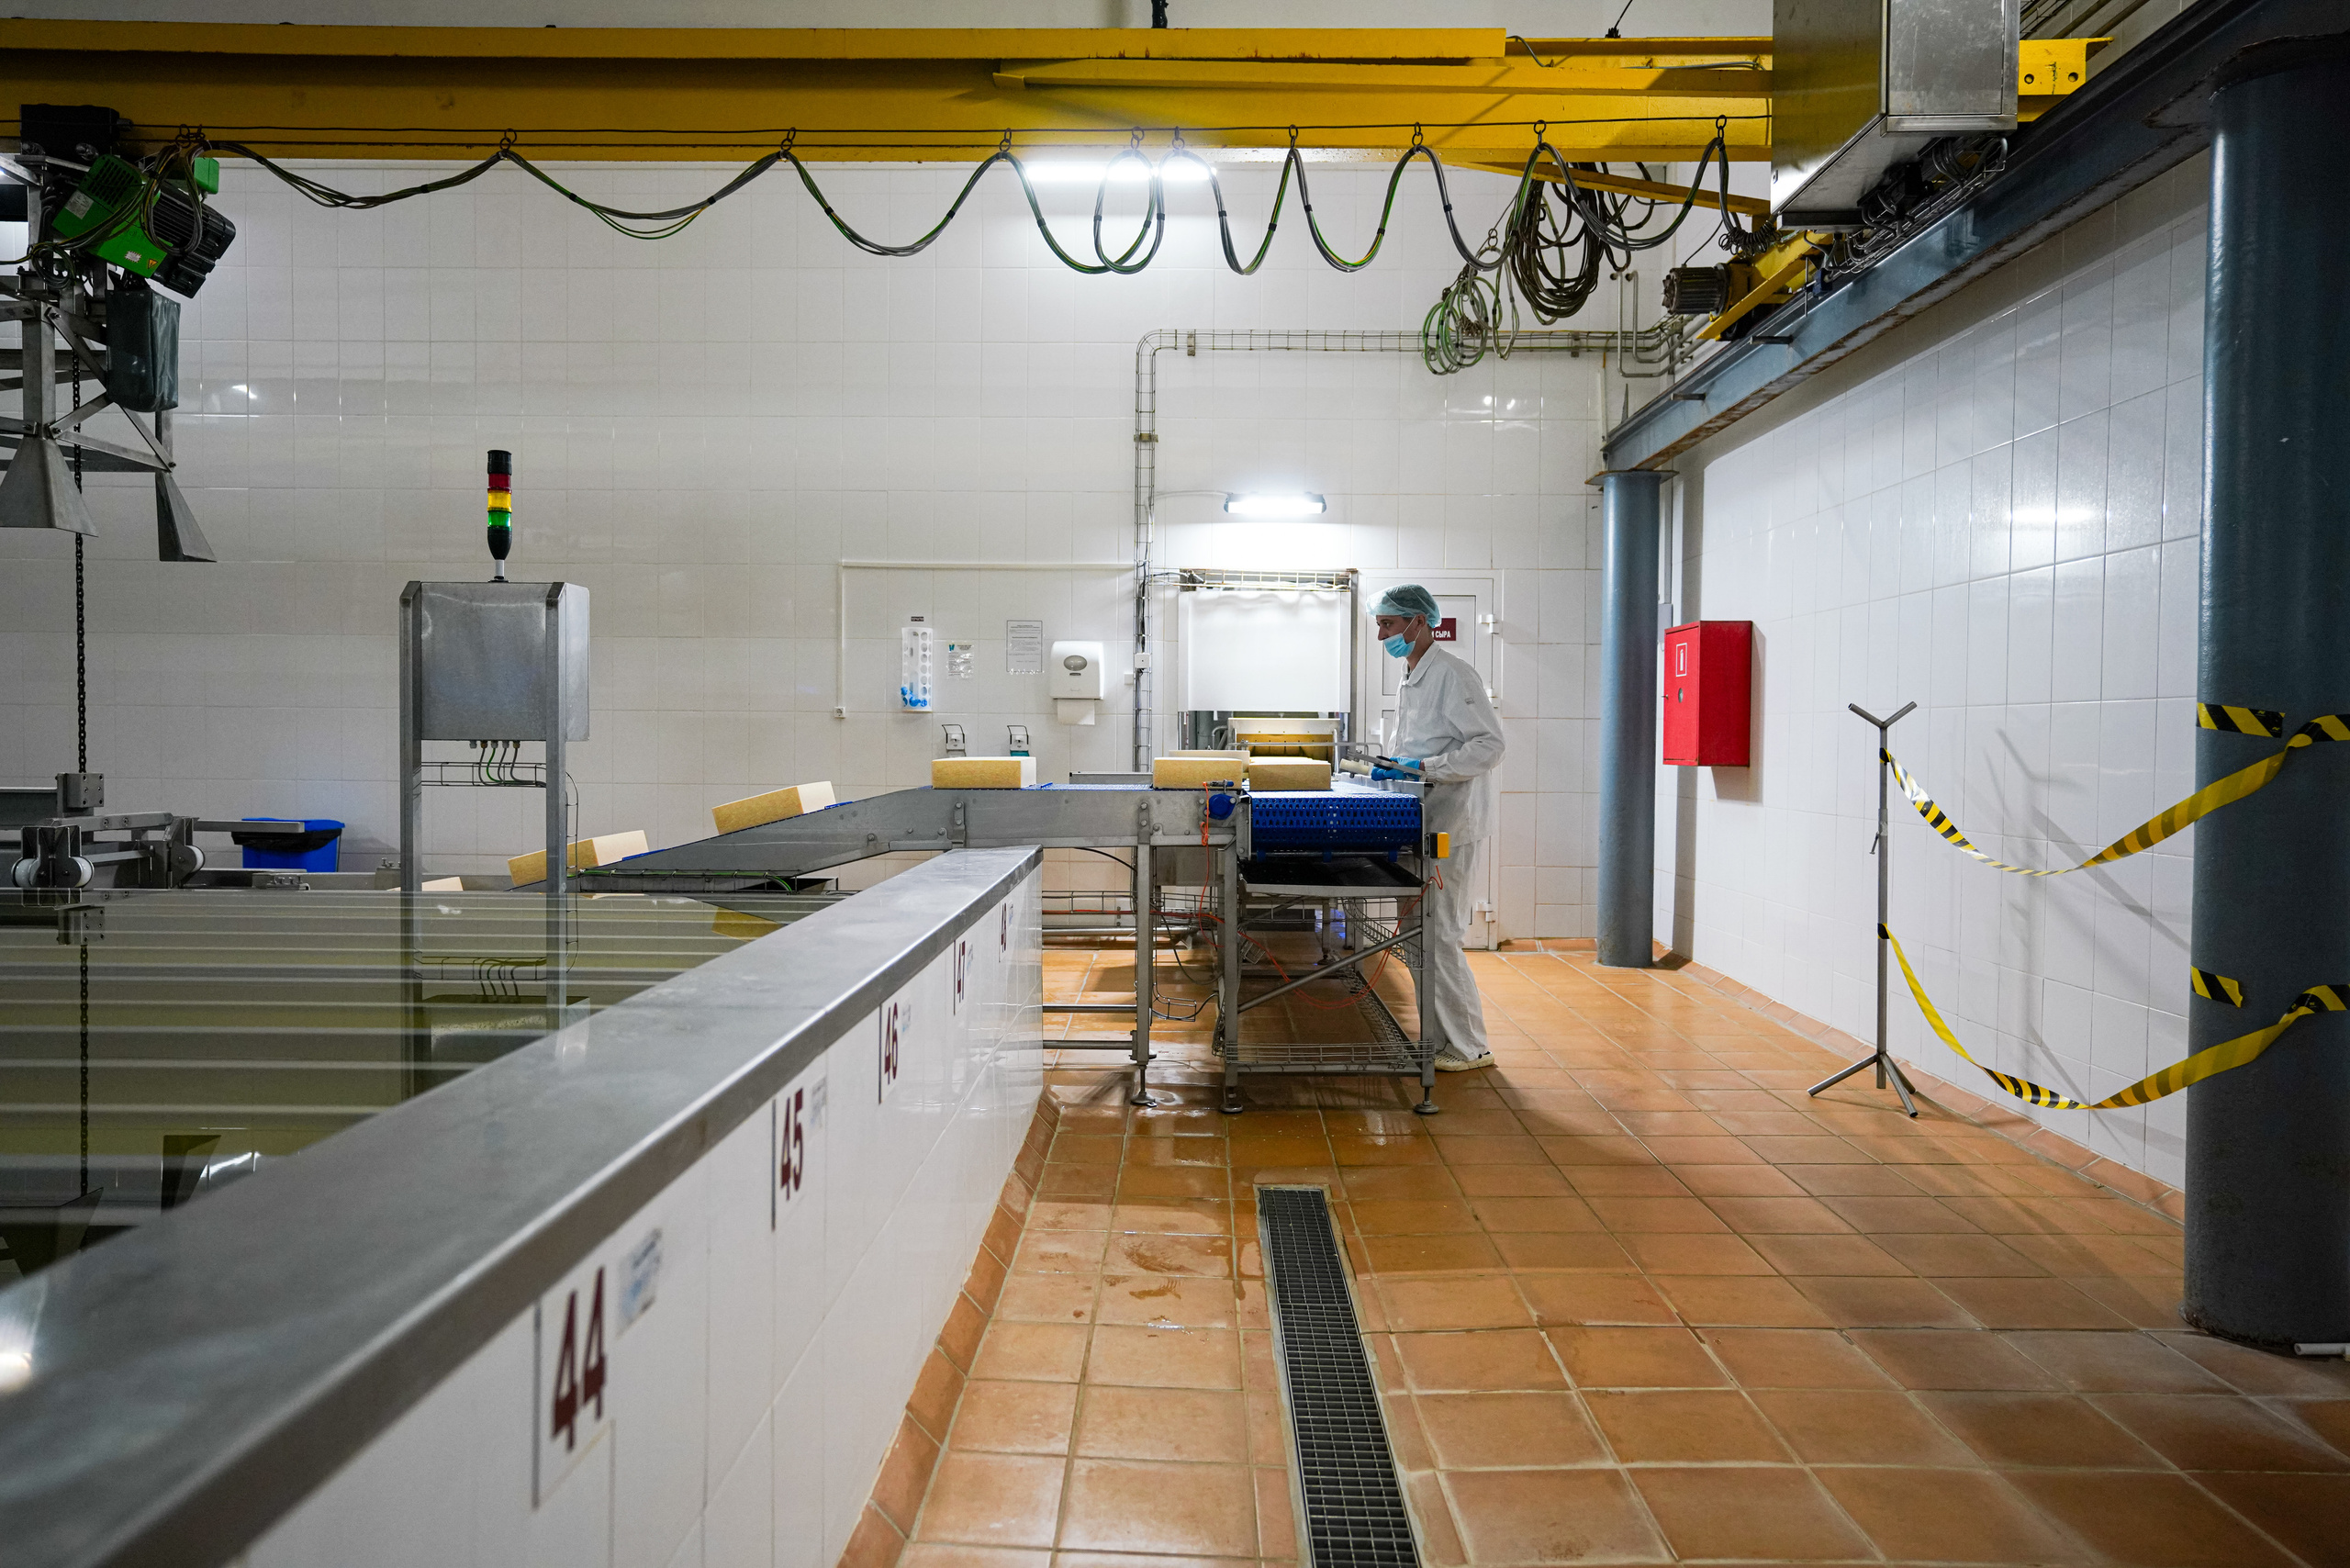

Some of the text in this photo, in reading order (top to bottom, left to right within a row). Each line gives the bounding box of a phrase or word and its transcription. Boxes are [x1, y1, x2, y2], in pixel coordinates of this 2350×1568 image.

[957, 940, 966, 1003] 47
[884, 1002, 899, 1085] 46
[780, 1088, 803, 1201] 45
[550, 1264, 608, 1452] 44
